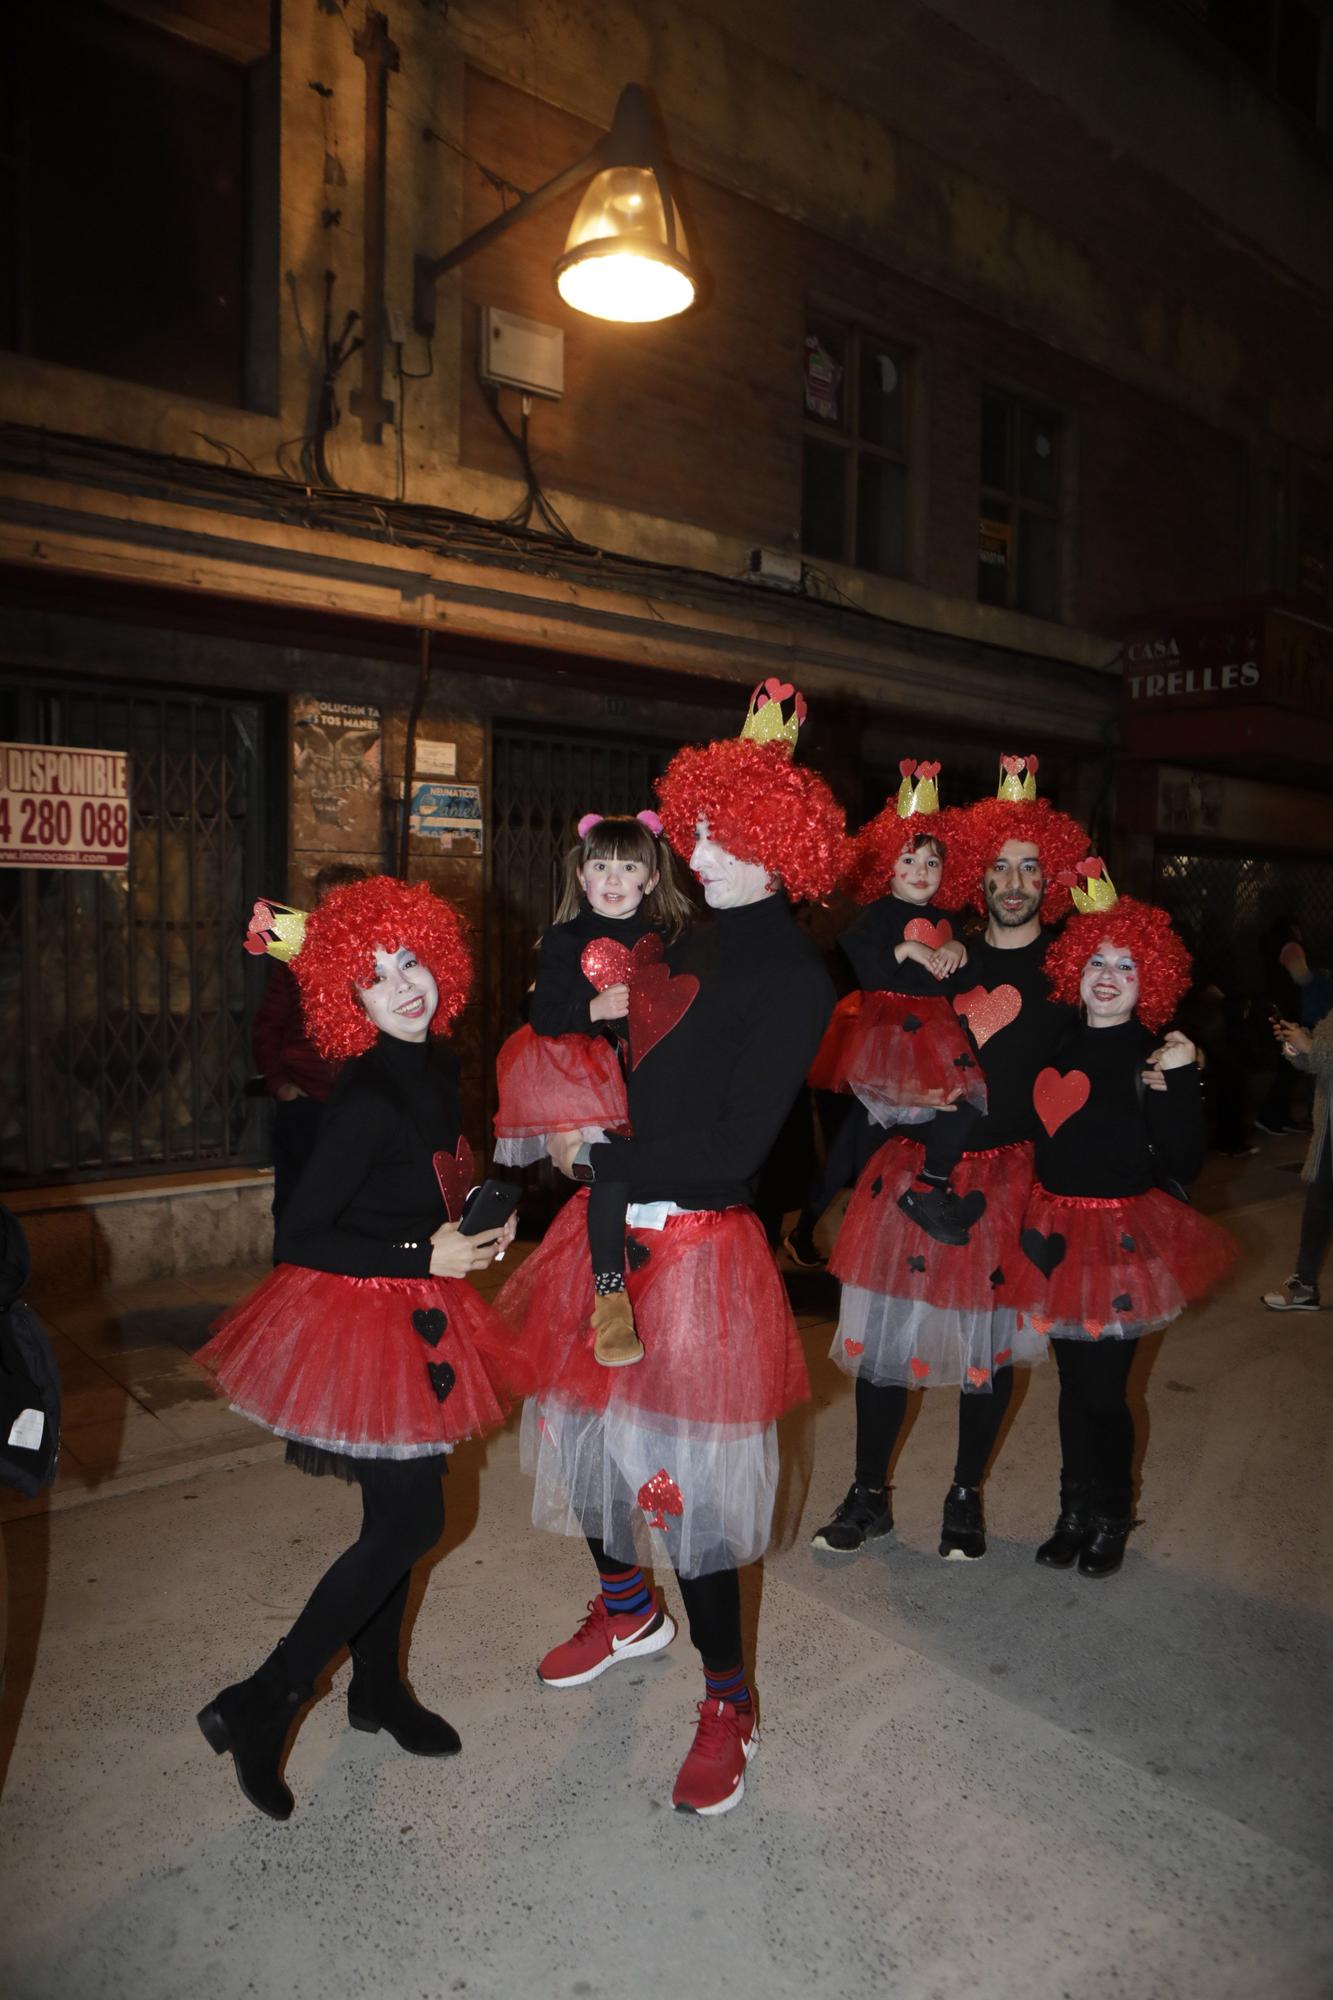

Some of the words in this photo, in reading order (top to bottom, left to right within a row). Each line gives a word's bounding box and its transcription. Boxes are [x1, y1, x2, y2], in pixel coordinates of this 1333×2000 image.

[1128, 637, 1181, 662] CASA
[1128, 661, 1260, 700] TRELLES
[320, 715, 342, 726] TOS
[7, 749, 126, 797] DISPONIBLE
[20, 798, 72, 846] 280
[81, 800, 127, 848] 088
